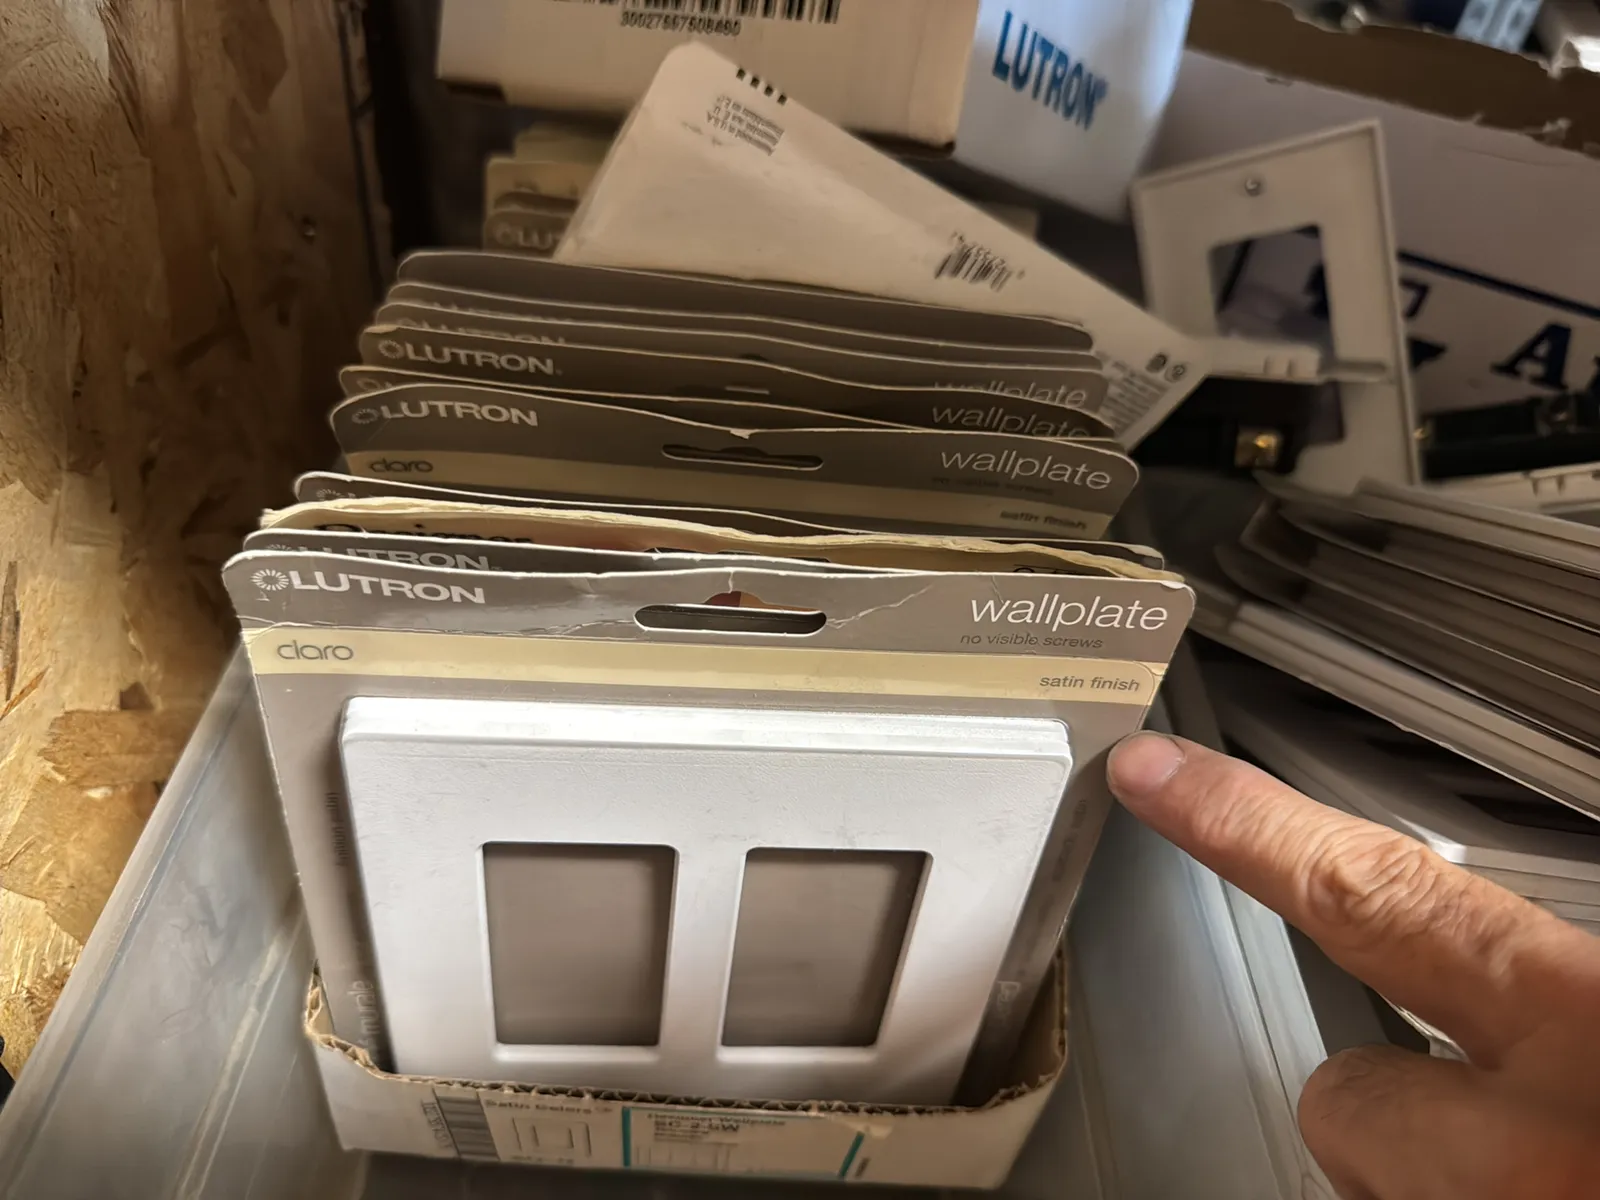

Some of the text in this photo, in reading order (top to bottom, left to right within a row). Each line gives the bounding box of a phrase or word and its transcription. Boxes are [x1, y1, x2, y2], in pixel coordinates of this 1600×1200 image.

[992, 10, 1094, 131] LUTRON
[405, 341, 554, 376] LUTRON
[381, 401, 539, 427] LUTRON
[369, 457, 433, 473] claro
[941, 450, 1112, 490] wallplate
[291, 570, 486, 604] LUTRON
[971, 593, 1169, 632] wallplate
[277, 640, 354, 661] claro
[960, 632, 1103, 649] no visible screws
[1039, 675, 1140, 692] satin finish
